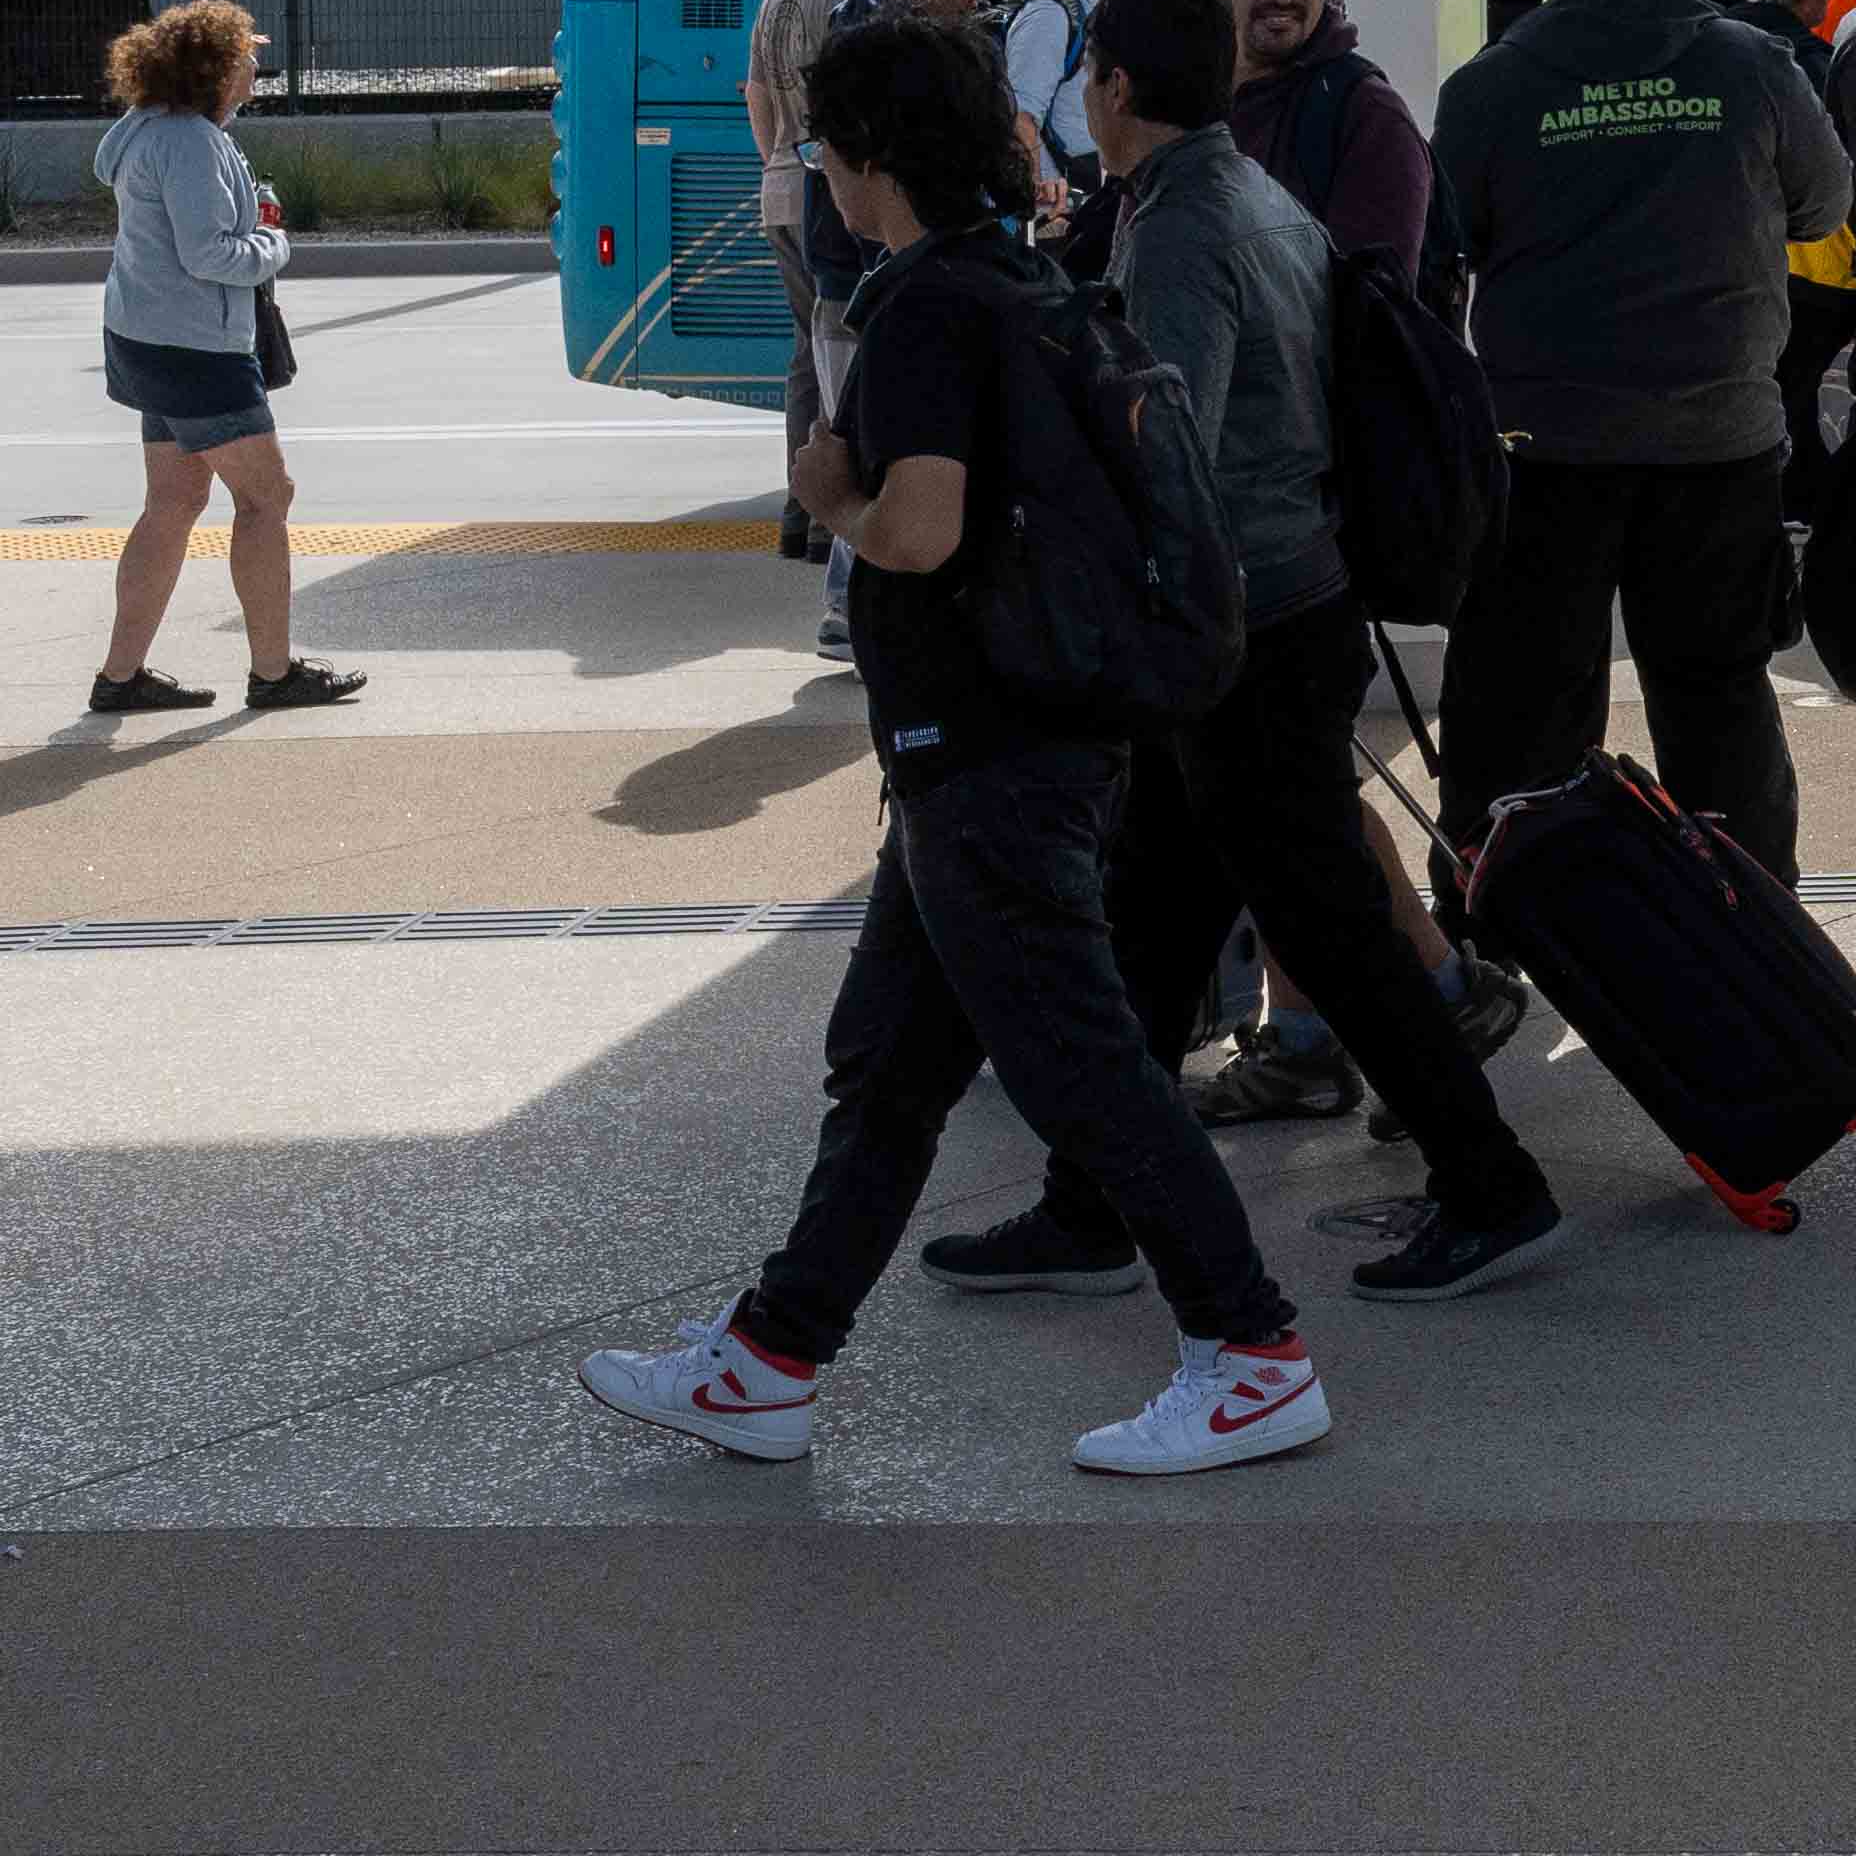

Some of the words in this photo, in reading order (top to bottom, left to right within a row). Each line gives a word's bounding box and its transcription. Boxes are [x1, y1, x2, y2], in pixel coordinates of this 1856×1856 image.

[1581, 77, 1676, 103] METRO
[1540, 96, 1724, 131] AMBASSADOR
[1540, 129, 1595, 148] SUPPORT
[1607, 122, 1664, 137] CONNECT
[1675, 120, 1722, 132] REPORT
